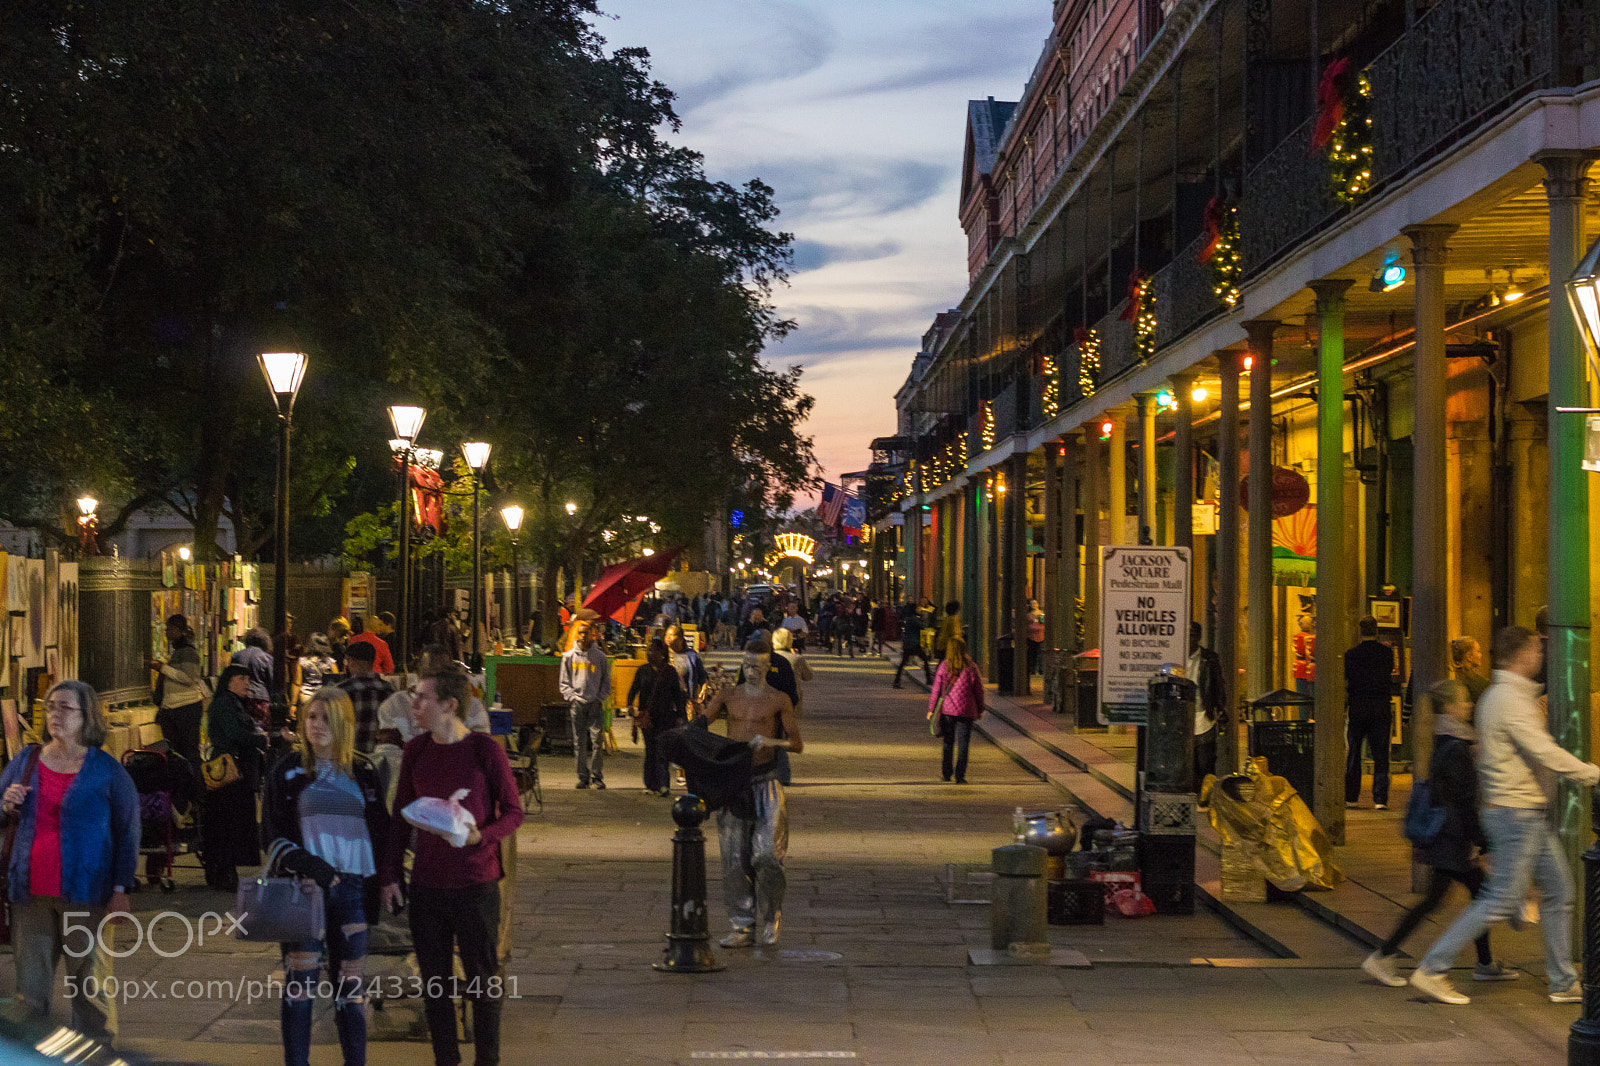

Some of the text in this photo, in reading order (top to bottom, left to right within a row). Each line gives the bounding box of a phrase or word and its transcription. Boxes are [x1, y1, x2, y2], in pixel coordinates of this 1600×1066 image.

[1119, 555, 1172, 568] JACKSON
[1122, 566, 1170, 580] SQUARE
[1110, 579, 1183, 590] Pedestrian Mall
[1137, 596, 1155, 609] NO
[1115, 609, 1177, 623] VEHICLES
[1116, 623, 1176, 636] ALLOWED
[1119, 639, 1171, 649] NO BICYCLING
[1119, 651, 1163, 661] NO SKATING
